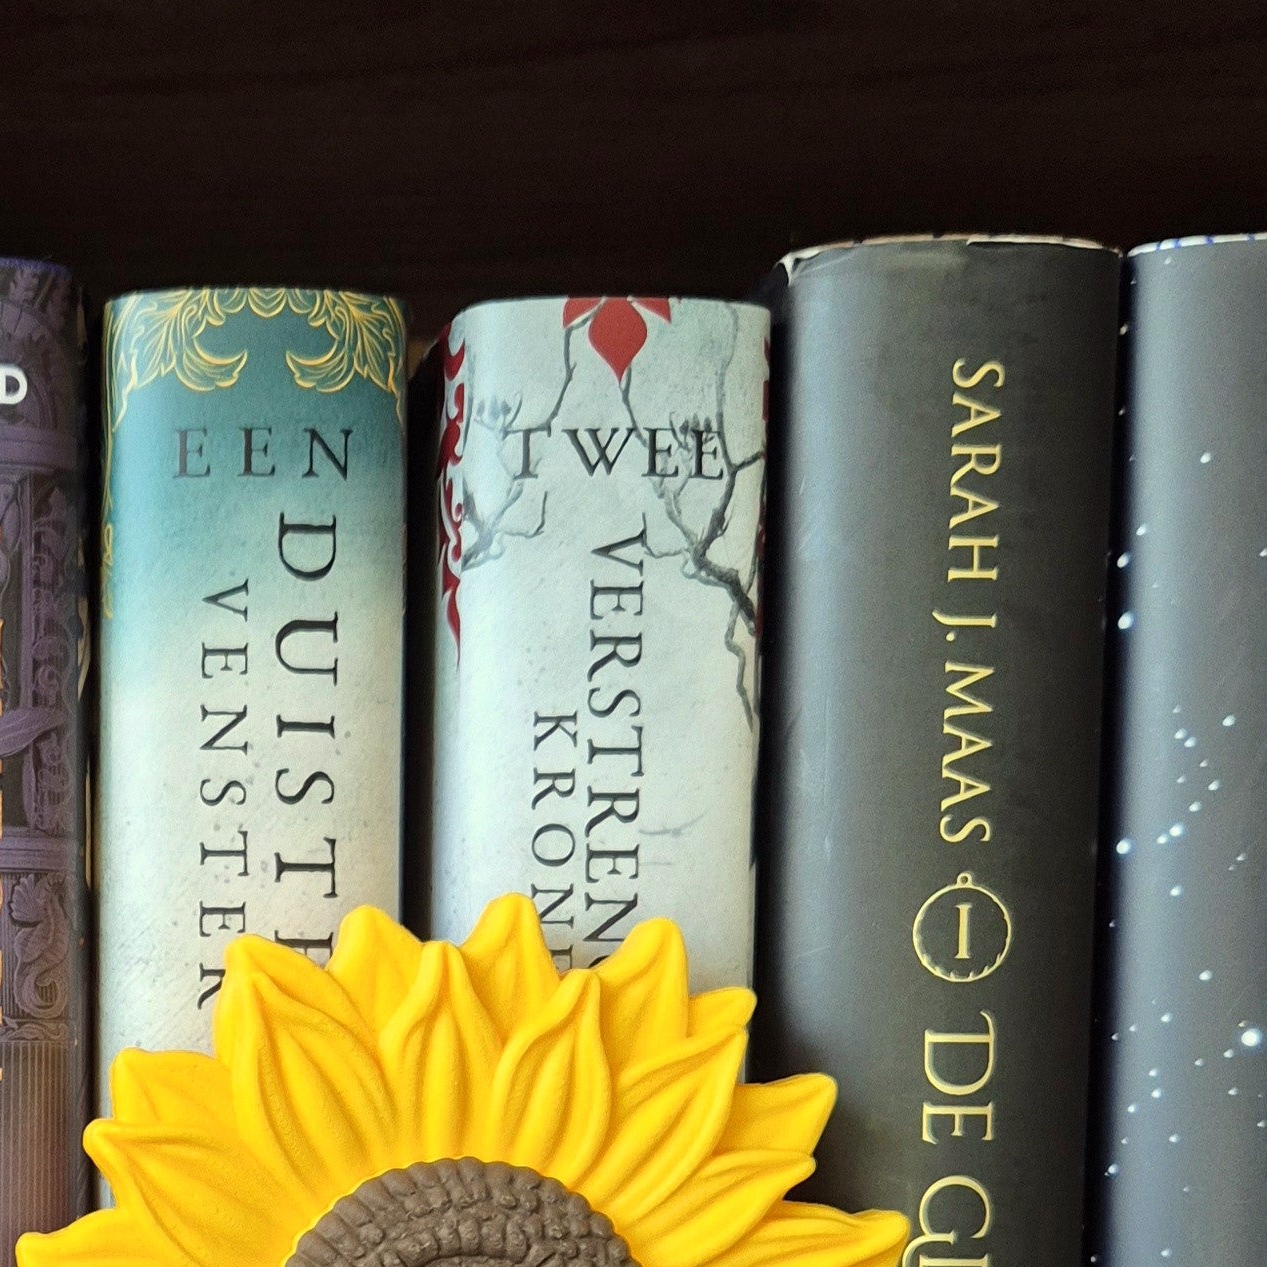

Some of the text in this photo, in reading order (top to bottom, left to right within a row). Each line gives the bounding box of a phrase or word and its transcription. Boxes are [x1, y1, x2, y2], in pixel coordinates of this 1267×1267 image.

[173, 426, 354, 481] EEN
[504, 426, 726, 481] TWEE
[932, 358, 1006, 844] SARAH J. MAAS
[581, 526, 647, 969] VERSTREN
[922, 1010, 998, 1145] DE
